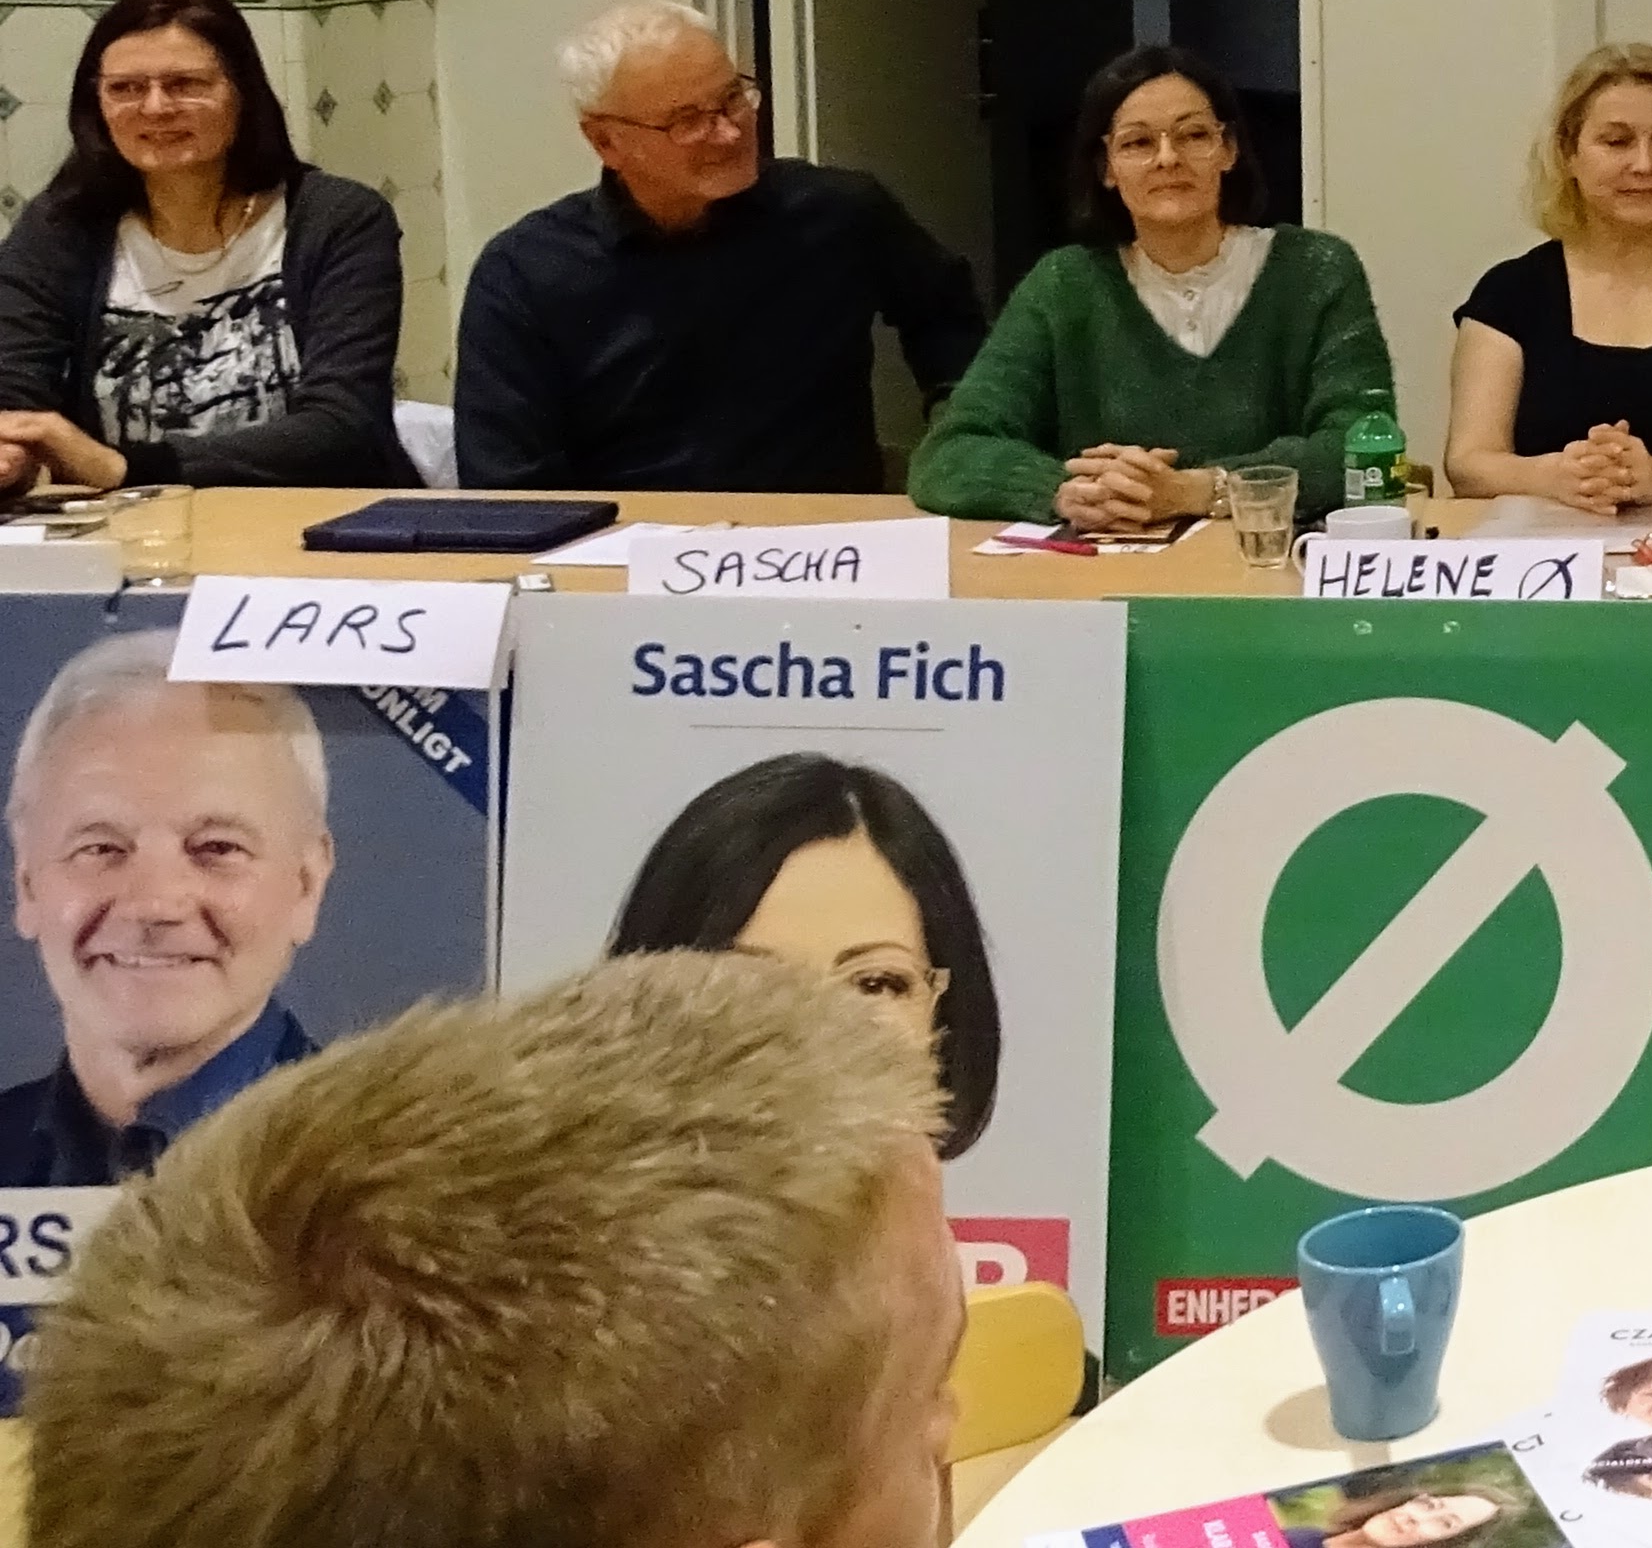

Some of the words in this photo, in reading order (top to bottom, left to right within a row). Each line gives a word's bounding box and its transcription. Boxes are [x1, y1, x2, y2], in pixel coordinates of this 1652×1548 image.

[664, 546, 862, 593] SASCHA
[1318, 550, 1498, 598] HELENE
[211, 594, 427, 654] LARS
[633, 642, 856, 700] Sascha
[877, 642, 1005, 702] Fich
